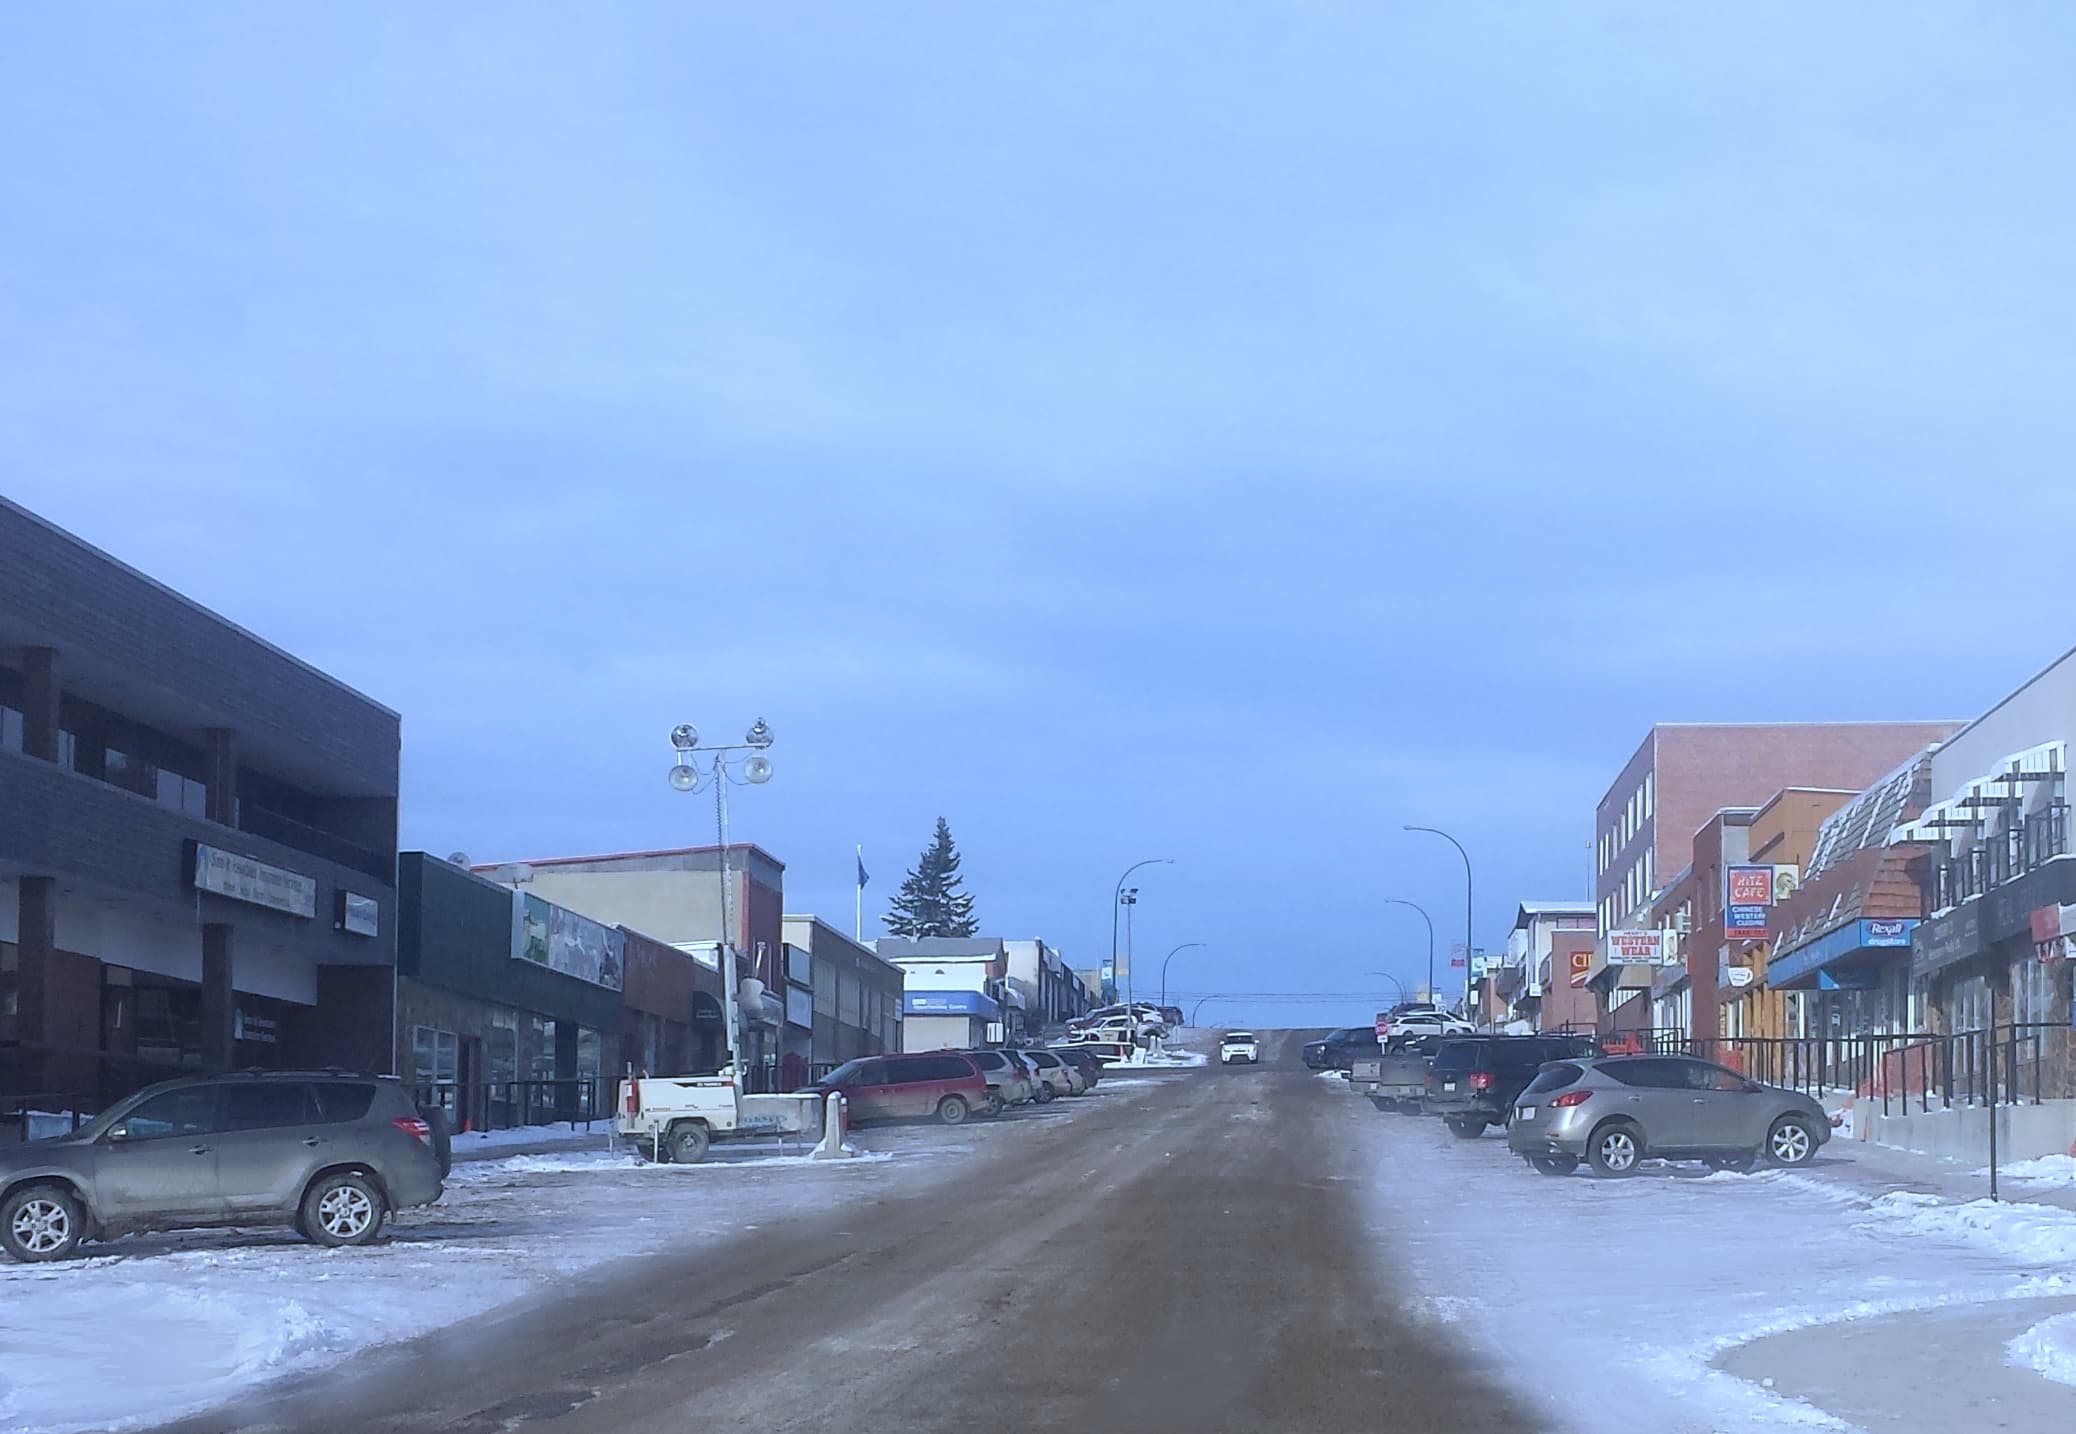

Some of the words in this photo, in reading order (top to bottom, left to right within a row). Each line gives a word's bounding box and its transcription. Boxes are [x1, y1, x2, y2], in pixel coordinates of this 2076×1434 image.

[1737, 875, 1763, 886] RITZ
[1734, 887, 1765, 898] CAFE
[1872, 923, 1902, 935] Rexall
[1611, 936, 1660, 945] WESTERN
[1621, 946, 1651, 955] WEAR
